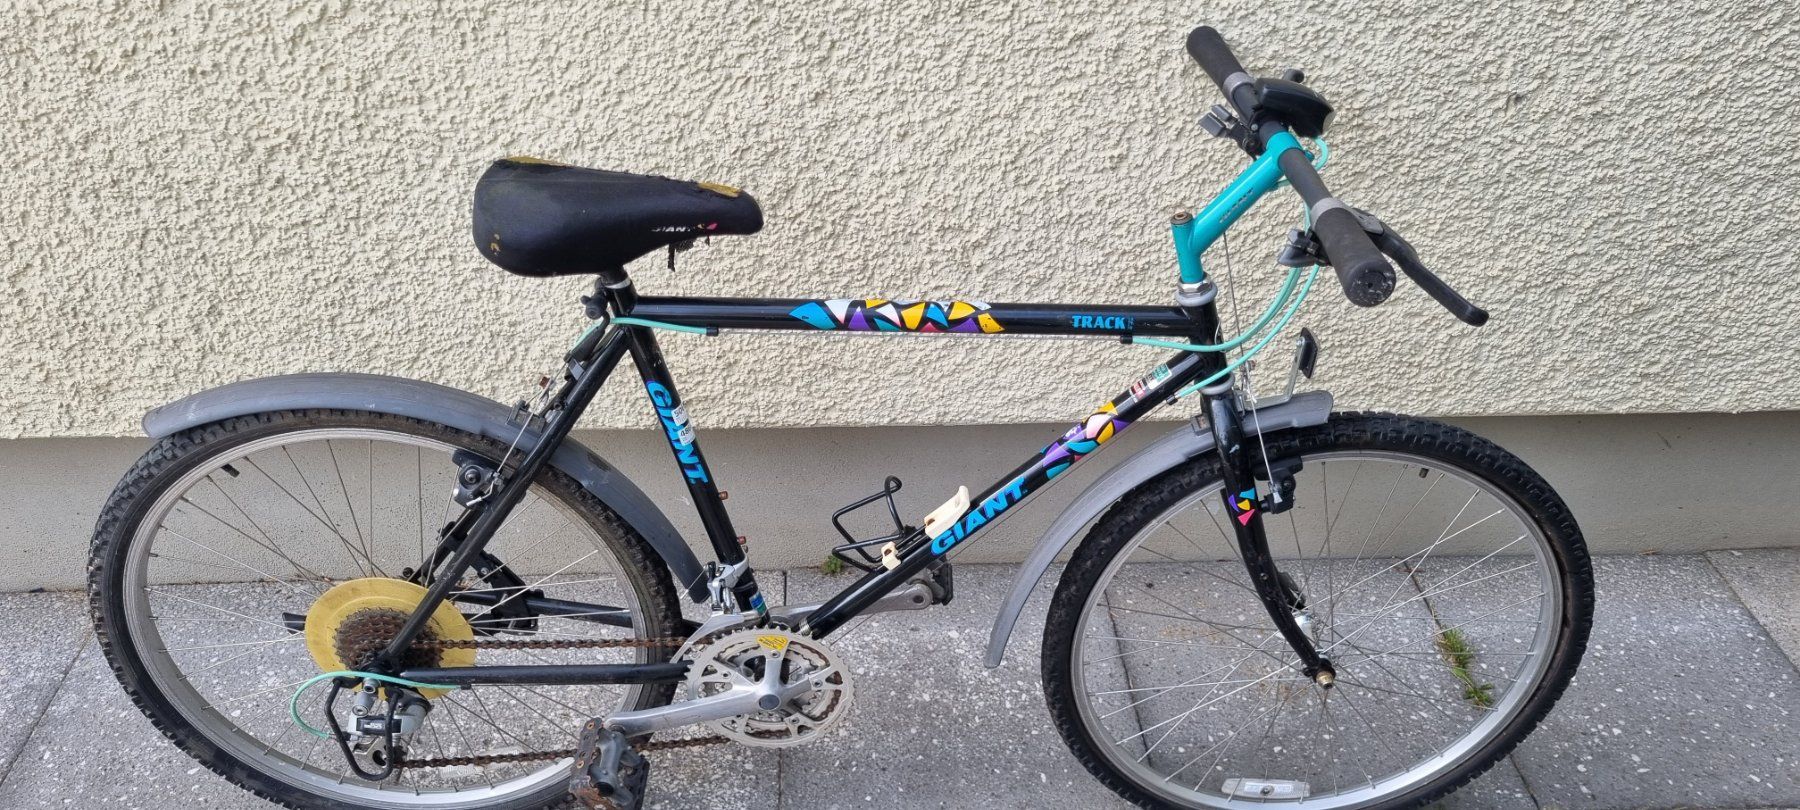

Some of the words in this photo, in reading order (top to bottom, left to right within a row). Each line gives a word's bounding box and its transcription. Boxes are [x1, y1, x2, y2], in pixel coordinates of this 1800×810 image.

[1071, 315, 1126, 330] TRACK
[646, 381, 709, 484] GIANT
[930, 476, 1025, 555] GIANT
